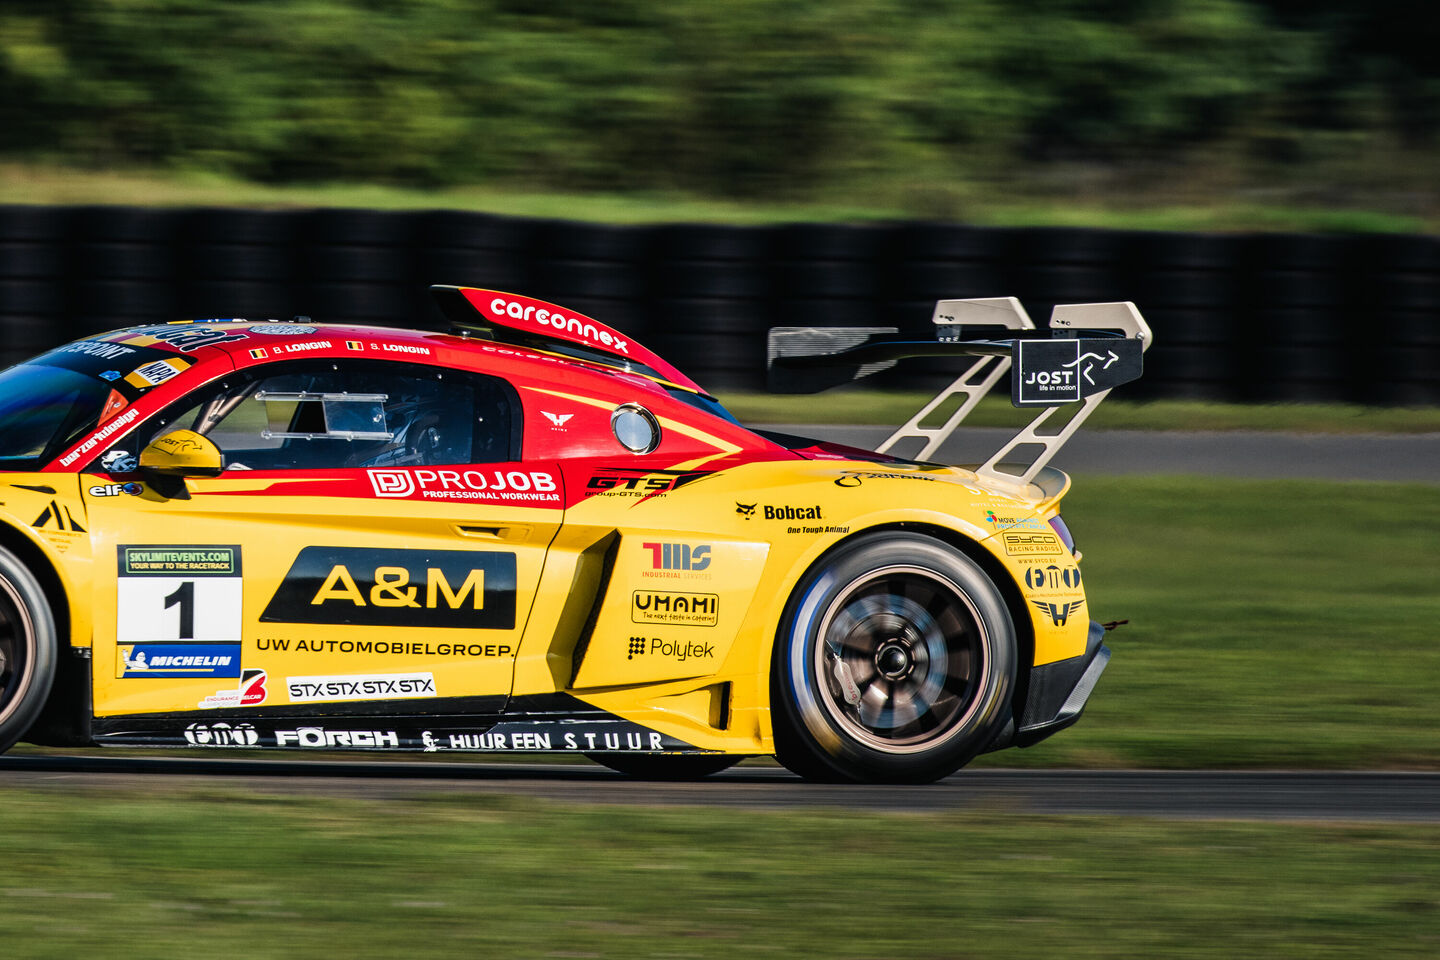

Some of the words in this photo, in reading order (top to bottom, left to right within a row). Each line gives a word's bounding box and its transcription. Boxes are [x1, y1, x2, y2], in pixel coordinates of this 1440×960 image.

[273, 346, 284, 354] B.
[286, 340, 332, 353] LONGIN
[382, 343, 430, 355] LONGIN
[138, 361, 177, 384] NAPA
[1025, 370, 1074, 385] JOST
[414, 470, 557, 491] PROJOB
[89, 484, 123, 497] elf
[423, 490, 500, 500] PROFESSIONAL
[501, 492, 561, 501] WORKWEAR
[764, 505, 822, 520] Bobcat
[787, 526, 801, 534] One
[802, 526, 823, 535] Tough
[824, 525, 850, 534] Animal
[1006, 535, 1057, 544] SYCO
[129, 552, 230, 562] SKYLIMITEVENTS.COM
[189, 562, 230, 570] RACETRACK
[642, 571, 681, 579] INDUSTRIAL
[683, 572, 712, 580] SERVICES
[310, 564, 485, 611] A&M
[164, 581, 194, 639] 1
[635, 594, 716, 614] UMAMI
[643, 611, 652, 619] The
[654, 613, 667, 621] next
[669, 613, 684, 621] taste
[692, 615, 715, 623] catering
[256, 638, 291, 651] UW
[295, 640, 515, 658] AUTOMOBIELGROEP.
[651, 638, 715, 661] Polytek
[149, 656, 232, 666] MICHELIN
[290, 683, 326, 698] STX
[327, 681, 362, 696] STX
[363, 680, 398, 695] STX
[400, 678, 435, 693] STX
[449, 733, 508, 750] HUUR
[511, 733, 552, 750] EEN
